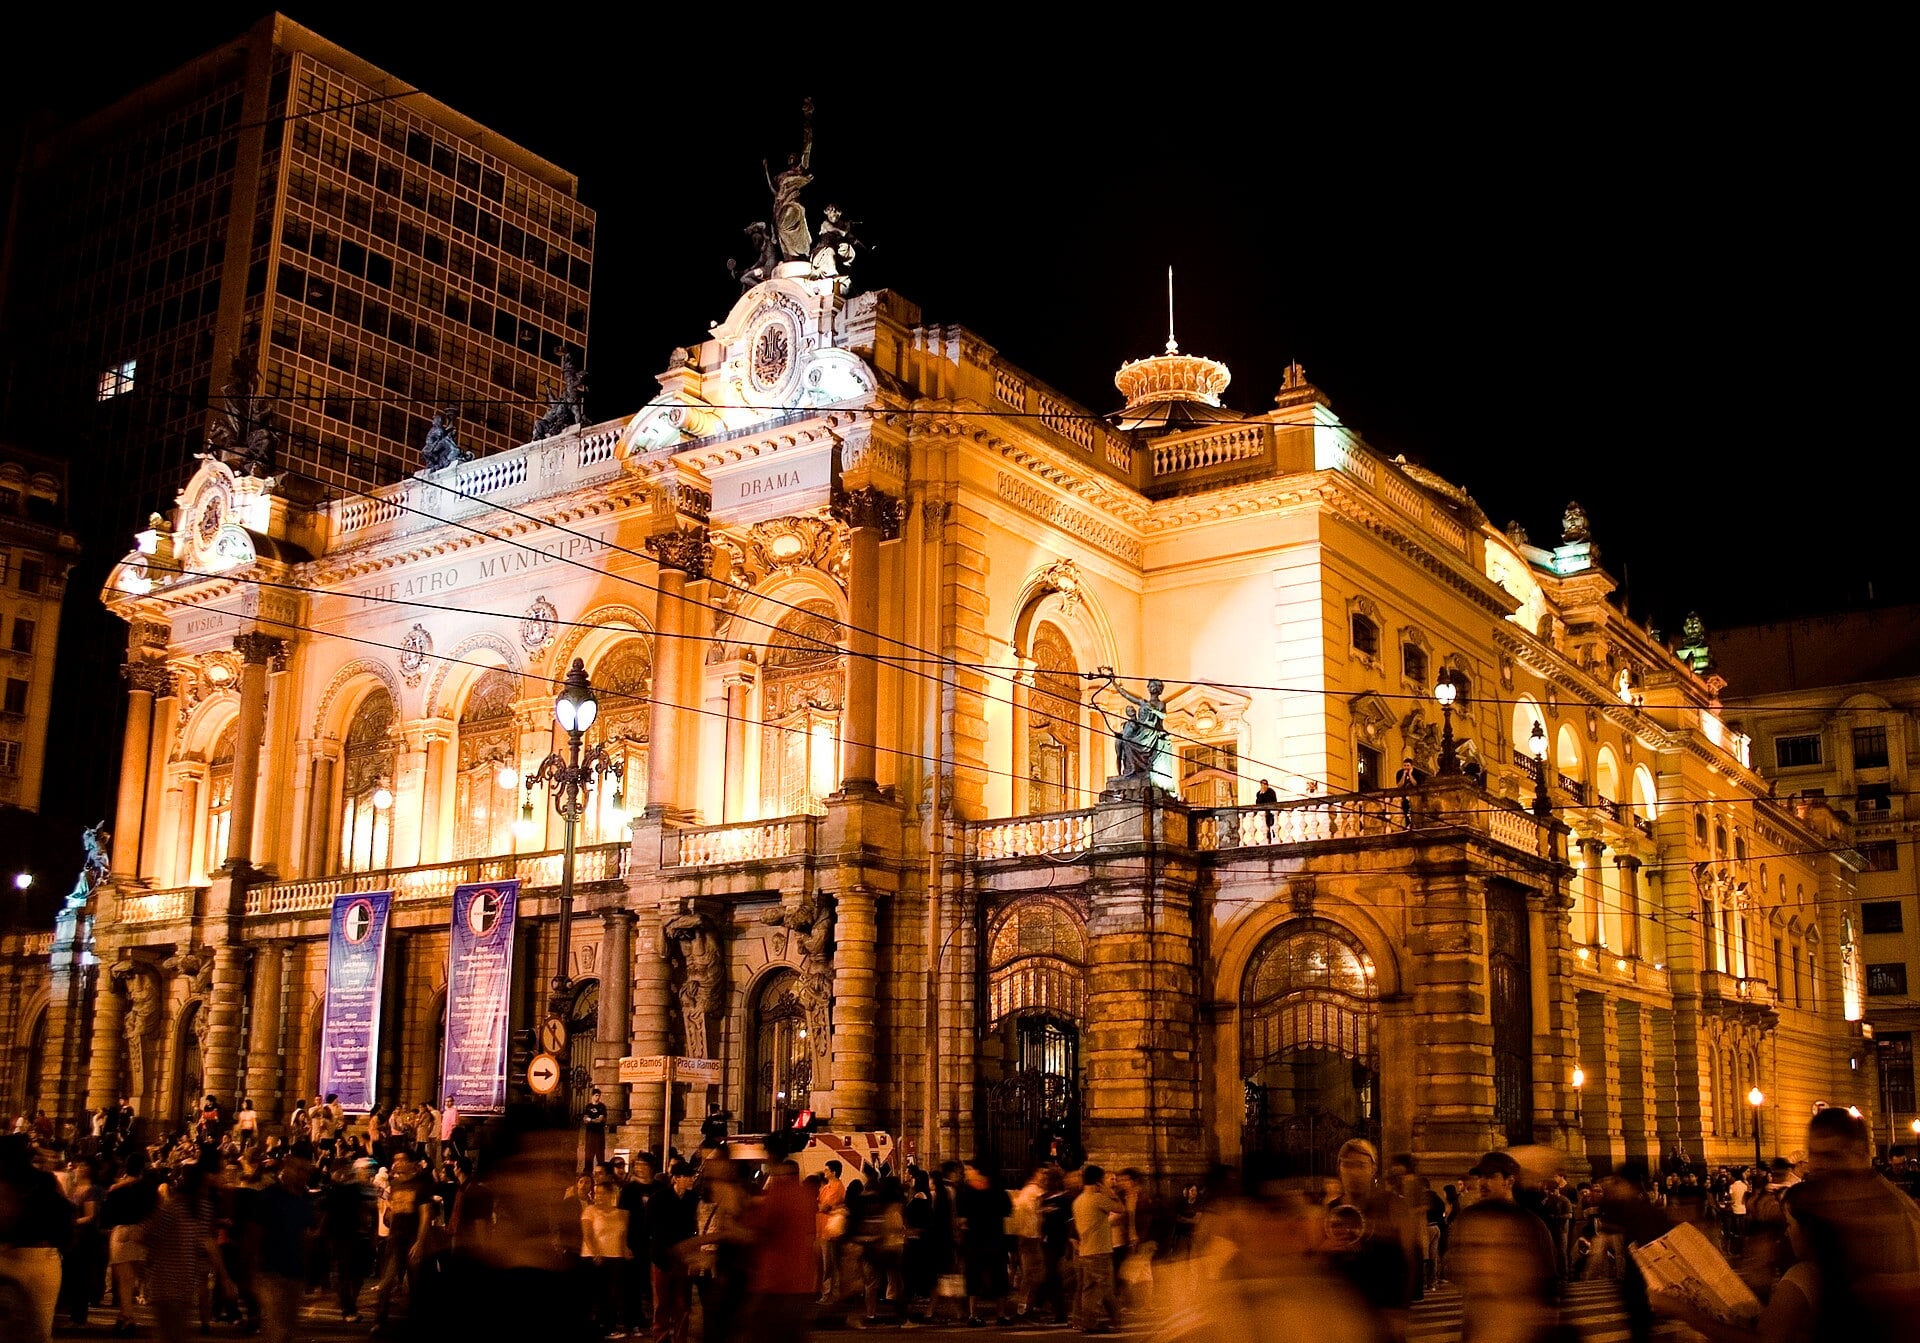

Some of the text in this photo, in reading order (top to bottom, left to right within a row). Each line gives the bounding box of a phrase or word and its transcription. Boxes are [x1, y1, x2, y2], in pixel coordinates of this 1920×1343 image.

[741, 470, 800, 497] DRAMA
[360, 531, 613, 607] THEATRO MVNICIPAL
[186, 615, 223, 634] MVSICA
[620, 1058, 662, 1070] Praça Ramos
[677, 1058, 719, 1071] Praça Ramos
